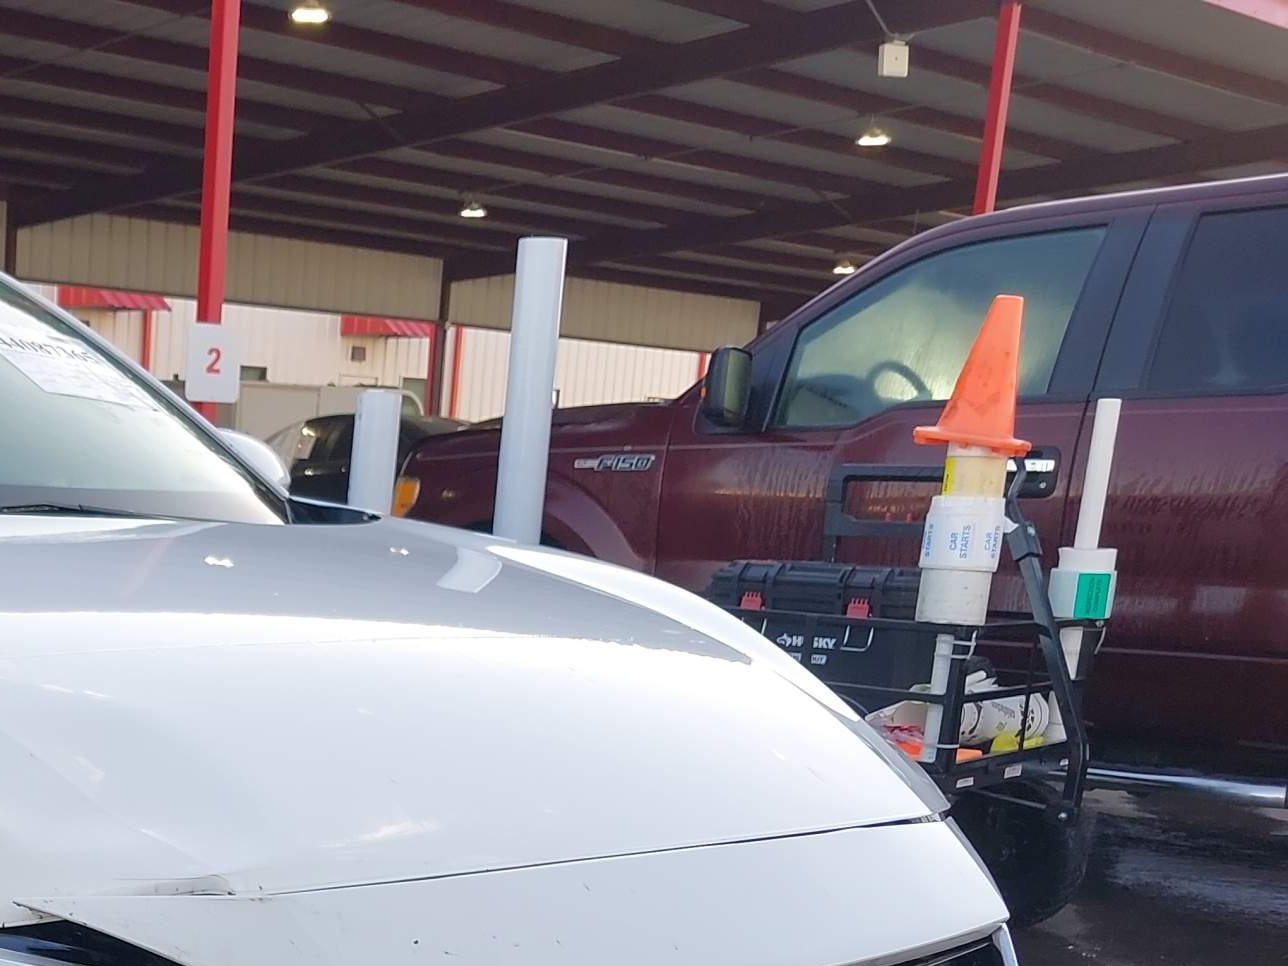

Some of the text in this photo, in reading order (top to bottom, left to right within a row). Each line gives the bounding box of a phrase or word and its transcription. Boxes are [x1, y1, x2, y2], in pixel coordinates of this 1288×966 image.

[206, 348, 221, 374] 2
[949, 532, 958, 551] CAR
[959, 523, 972, 559] STARTS
[792, 635, 837, 649] HSKY
